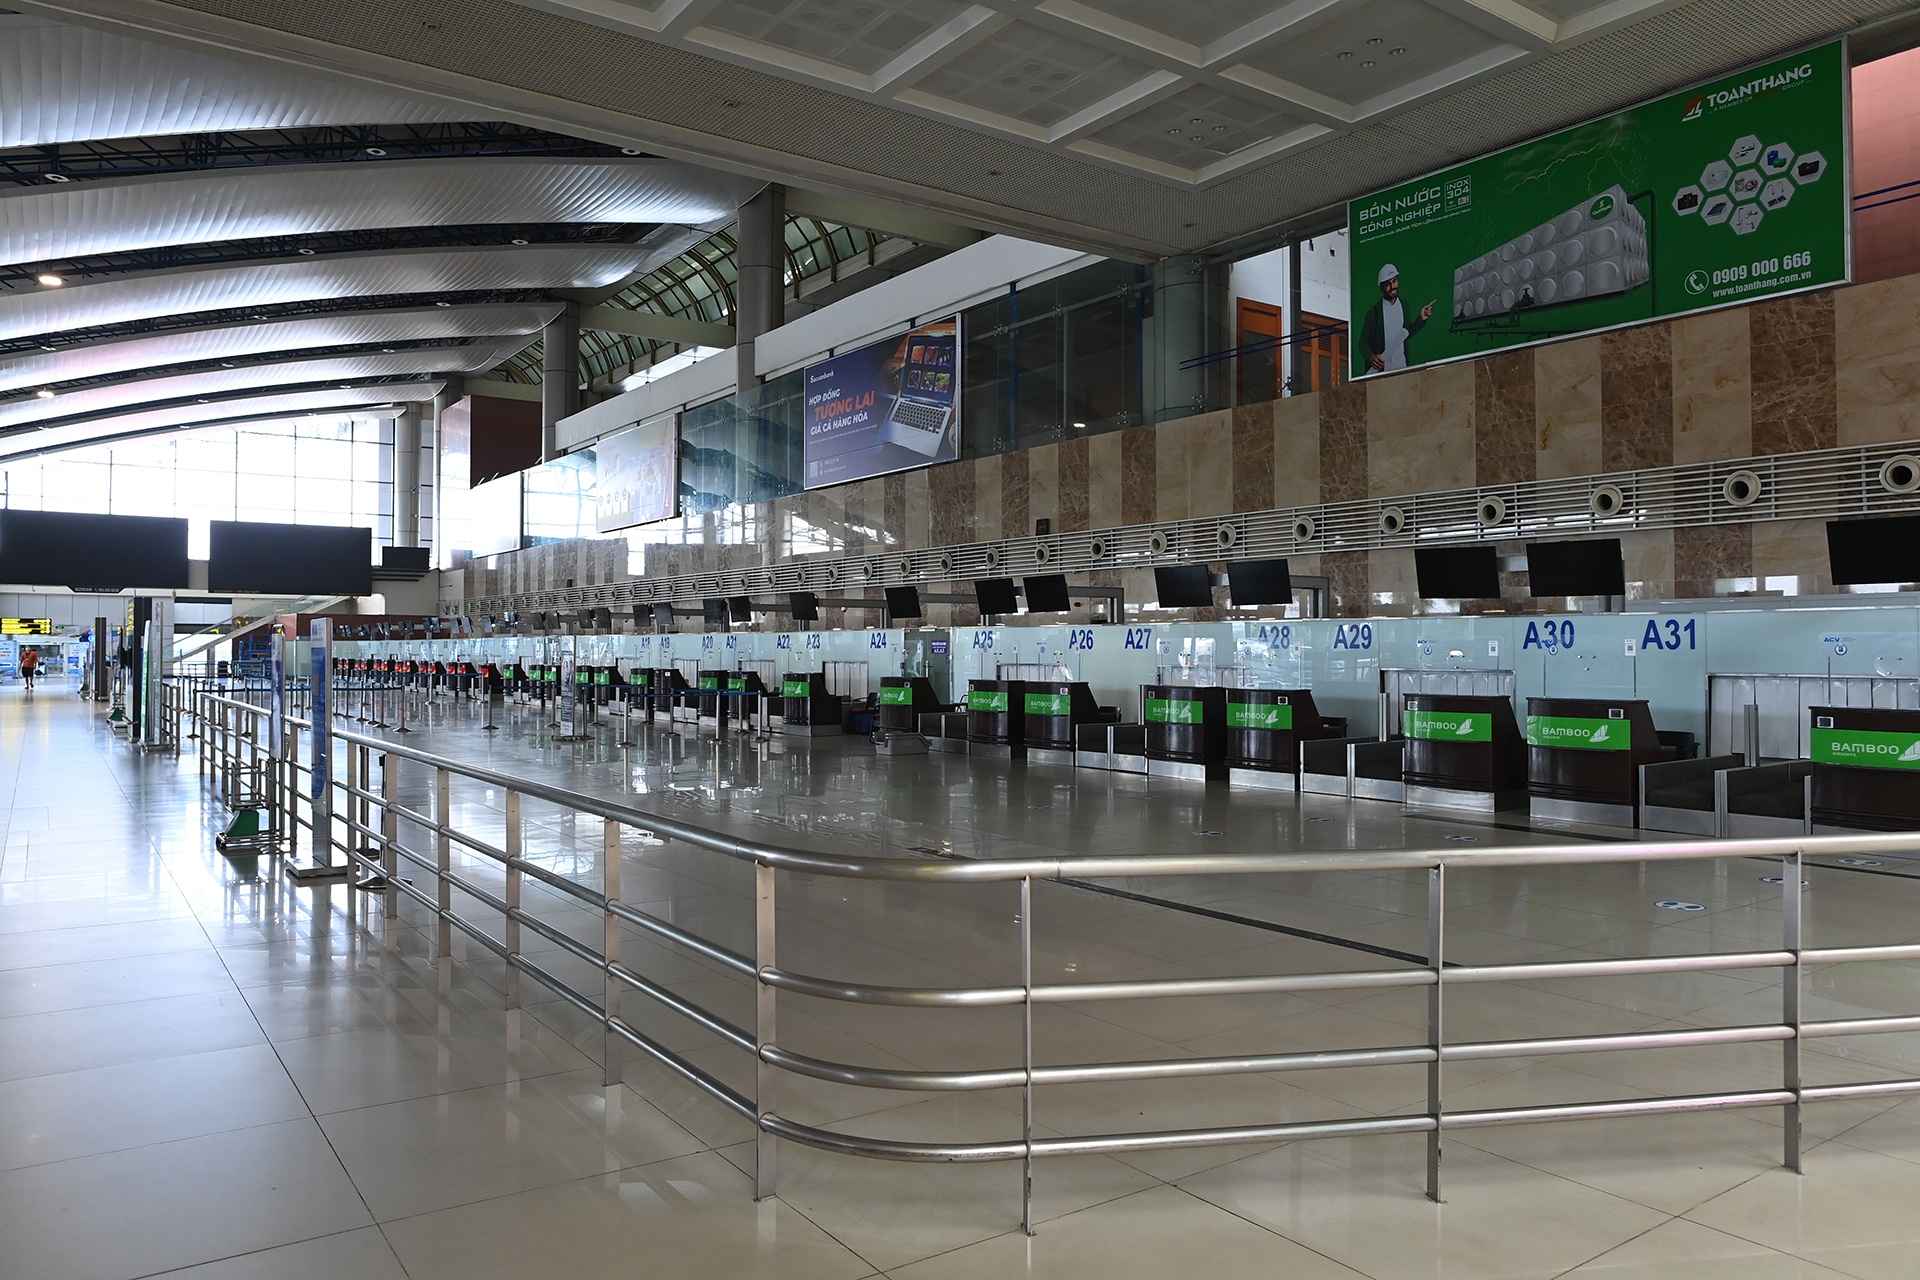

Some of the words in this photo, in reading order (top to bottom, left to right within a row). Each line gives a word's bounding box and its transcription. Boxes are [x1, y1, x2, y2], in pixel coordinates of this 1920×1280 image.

[1707, 64, 1812, 107] TOANTHANG
[1446, 178, 1469, 191] INOX
[1446, 185, 1470, 199] 304
[1360, 201, 1392, 221] BỒN
[1395, 187, 1440, 209] NƯỚC
[1360, 218, 1393, 234] CÔNG
[1395, 203, 1441, 224] NGHIỆP
[1713, 265, 1747, 285] 0909
[1751, 258, 1778, 276] 000
[1783, 251, 1811, 270] 666
[1713, 271, 1811, 298] www.toanthang.com.vn
[810, 370, 834, 384] Sacombank
[815, 397, 853, 420] TƯƠNG
[855, 390, 875, 410] LAI
[811, 422, 821, 435] GIÁ
[833, 416, 852, 430] HÀNG
[852, 410, 868, 424] HÓA
[777, 635, 791, 649] A22
[806, 634, 821, 649] A23
[870, 632, 887, 649] A24
[972, 630, 994, 649] A25
[1069, 629, 1094, 650] A26
[1125, 628, 1152, 649] A27
[1258, 625, 1290, 650] A28
[1333, 624, 1372, 650] A29
[1523, 620, 1574, 650] A30
[1641, 619, 1695, 650] A31
[1153, 707, 1180, 715] BAMBOO
[1235, 711, 1266, 720] BAMBOO
[1416, 721, 1457, 730] BAMBOO
[1542, 726, 1590, 737] BAMBOO
[1831, 742, 1900, 755] BAMBOO
